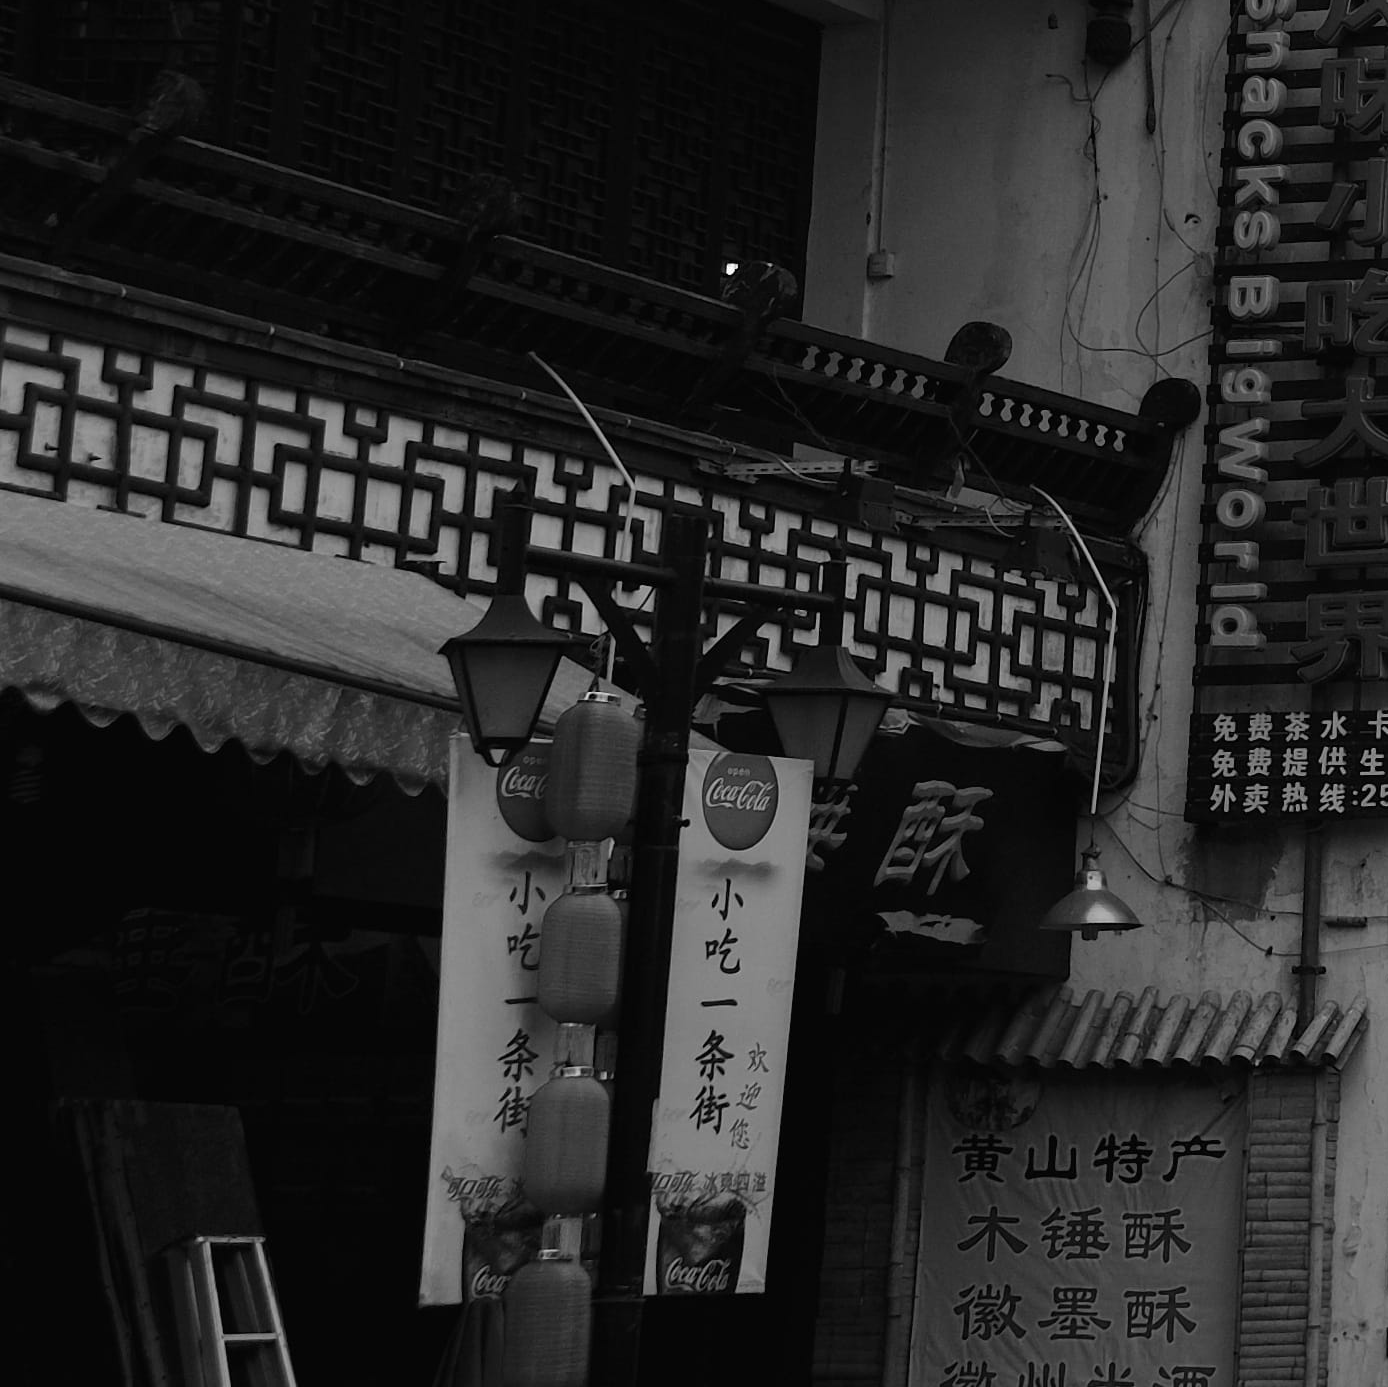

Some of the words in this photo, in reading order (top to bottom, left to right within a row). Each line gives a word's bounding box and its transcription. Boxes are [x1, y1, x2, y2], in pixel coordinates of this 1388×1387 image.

[1221, 275, 1281, 407] Big
[1210, 414, 1271, 652] World
[1212, 710, 1349, 742] 免费茶水
[727, 766, 751, 777] open
[689, 876, 742, 1137] 小吃一条街
[728, 1040, 771, 1152] 欢迎您
[951, 1133, 1227, 1184] 黄山特产
[957, 1206, 1192, 1263] 木锤酥
[953, 1284, 1198, 1343] 徽墨酥
